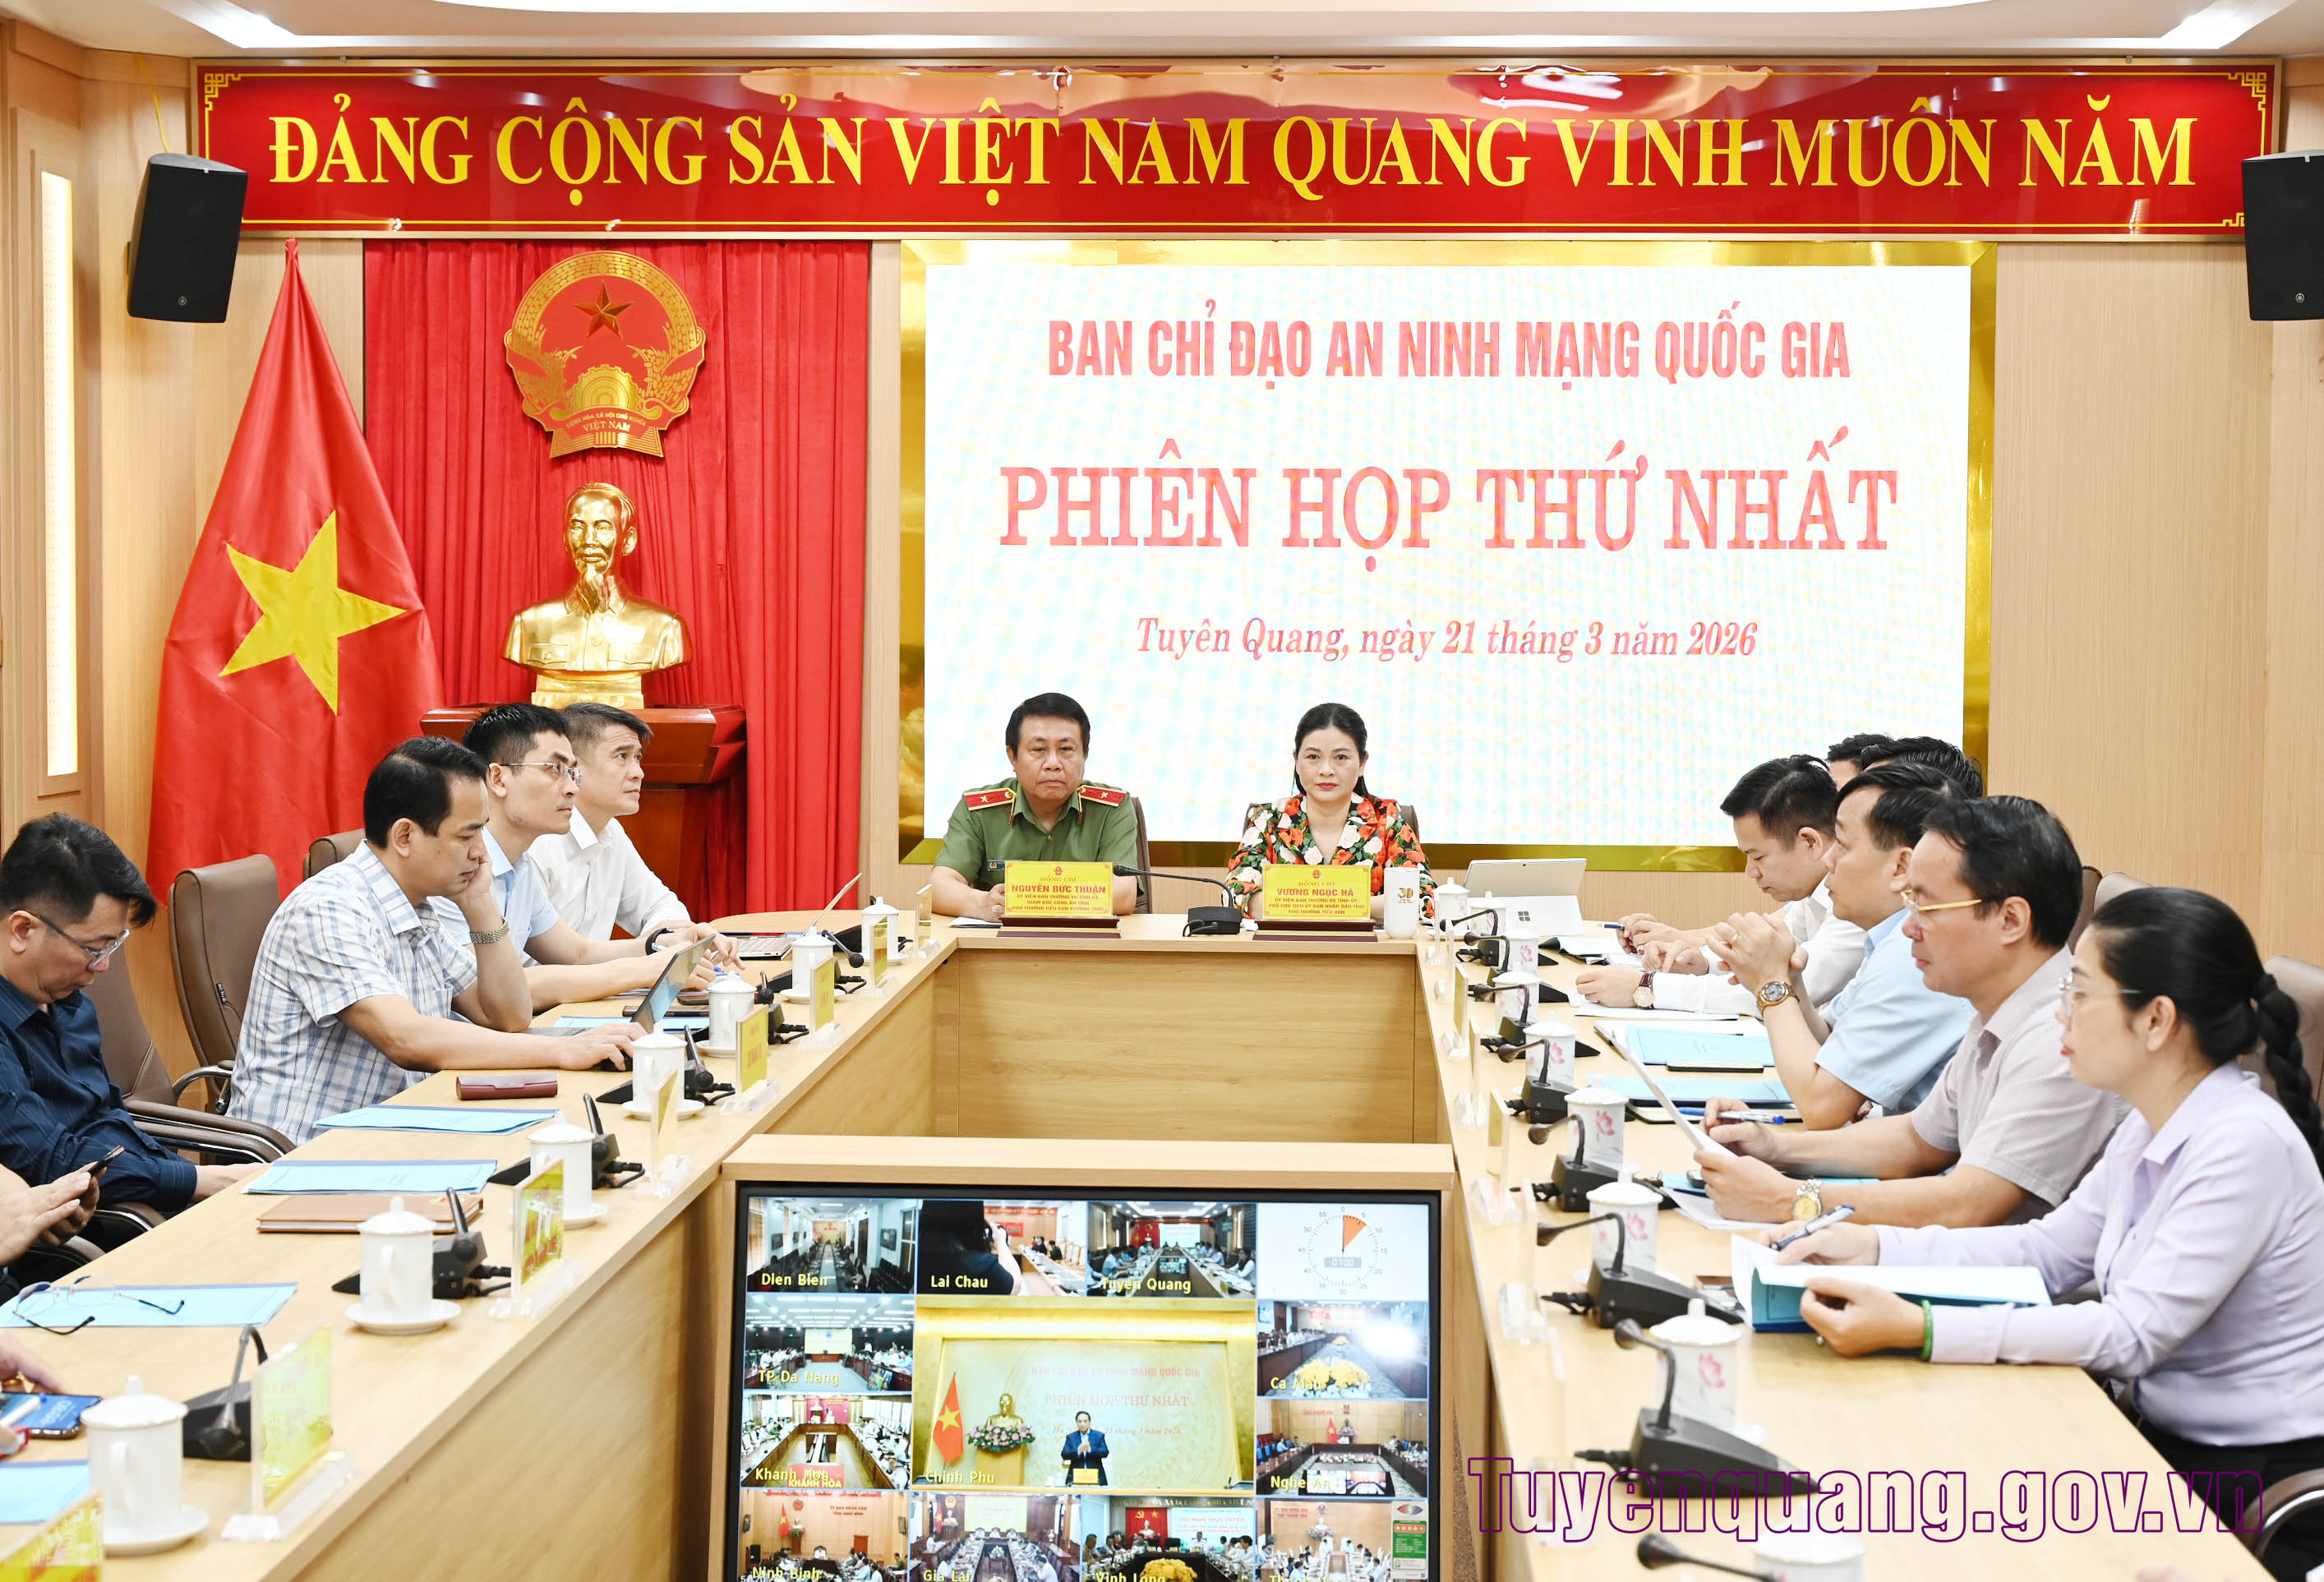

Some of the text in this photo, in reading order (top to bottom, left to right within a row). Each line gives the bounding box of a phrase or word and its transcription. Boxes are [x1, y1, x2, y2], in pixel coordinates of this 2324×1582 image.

[269, 93, 2198, 206] ĐẢNG CỘNG SẢN VIỆT NAM QUANG VINH MUÔN NĂM
[1049, 299, 1851, 391] BAN CHỈ ĐẠO AN NINH MẠNG QUỐC GIA
[608, 420, 631, 432] NAM
[1000, 426, 1898, 574] PHIÊN HỌP THỨ NHẤT
[1137, 617, 1759, 665] Tuyên Quang, ngày 21 tháng 3 năm 2026
[1012, 883, 1106, 894] NGUYỄN ĐỨC THUẬN
[1276, 887, 1354, 897] VƯƠNG NGỌC HÀ
[761, 1273, 828, 1286] Dien Bien
[930, 1275, 989, 1288] Lai Chau
[1102, 1276, 1192, 1294] Tuyen Quang
[805, 1371, 840, 1386] Nang
[1270, 1377, 1287, 1390] Ca
[755, 1467, 797, 1480] Khanh
[926, 1470, 995, 1483] Chinh Phu
[1270, 1475, 1306, 1492] Nghe
[753, 1566, 784, 1579] Ninh
[790, 1566, 821, 1580] Binh
[924, 1569, 971, 1582] Gia Lai
[1095, 1572, 1127, 1582] Vinh
